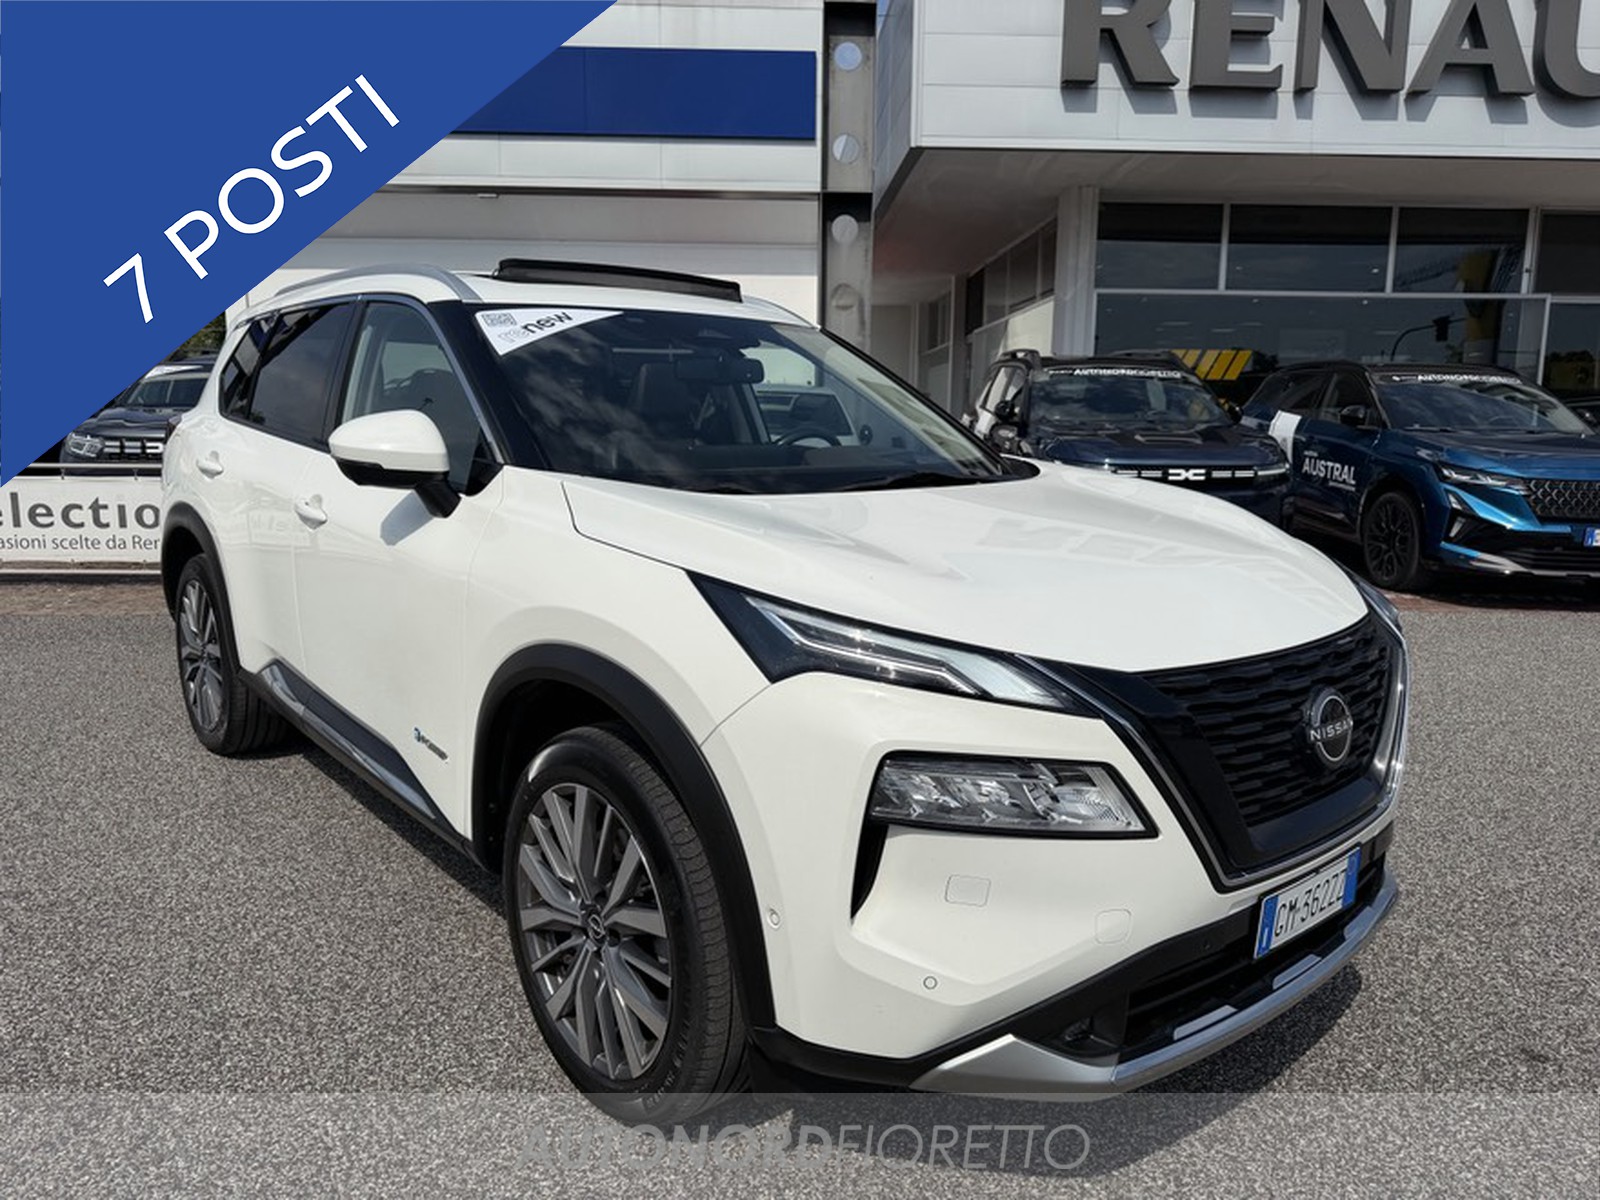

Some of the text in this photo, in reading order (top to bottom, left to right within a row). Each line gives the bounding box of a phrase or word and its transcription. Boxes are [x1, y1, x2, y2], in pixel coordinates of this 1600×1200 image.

[1301, 456, 1357, 485] AUSTRAL
[0, 491, 160, 529] lectio
[52, 534, 101, 550] scelte
[105, 534, 127, 550] da
